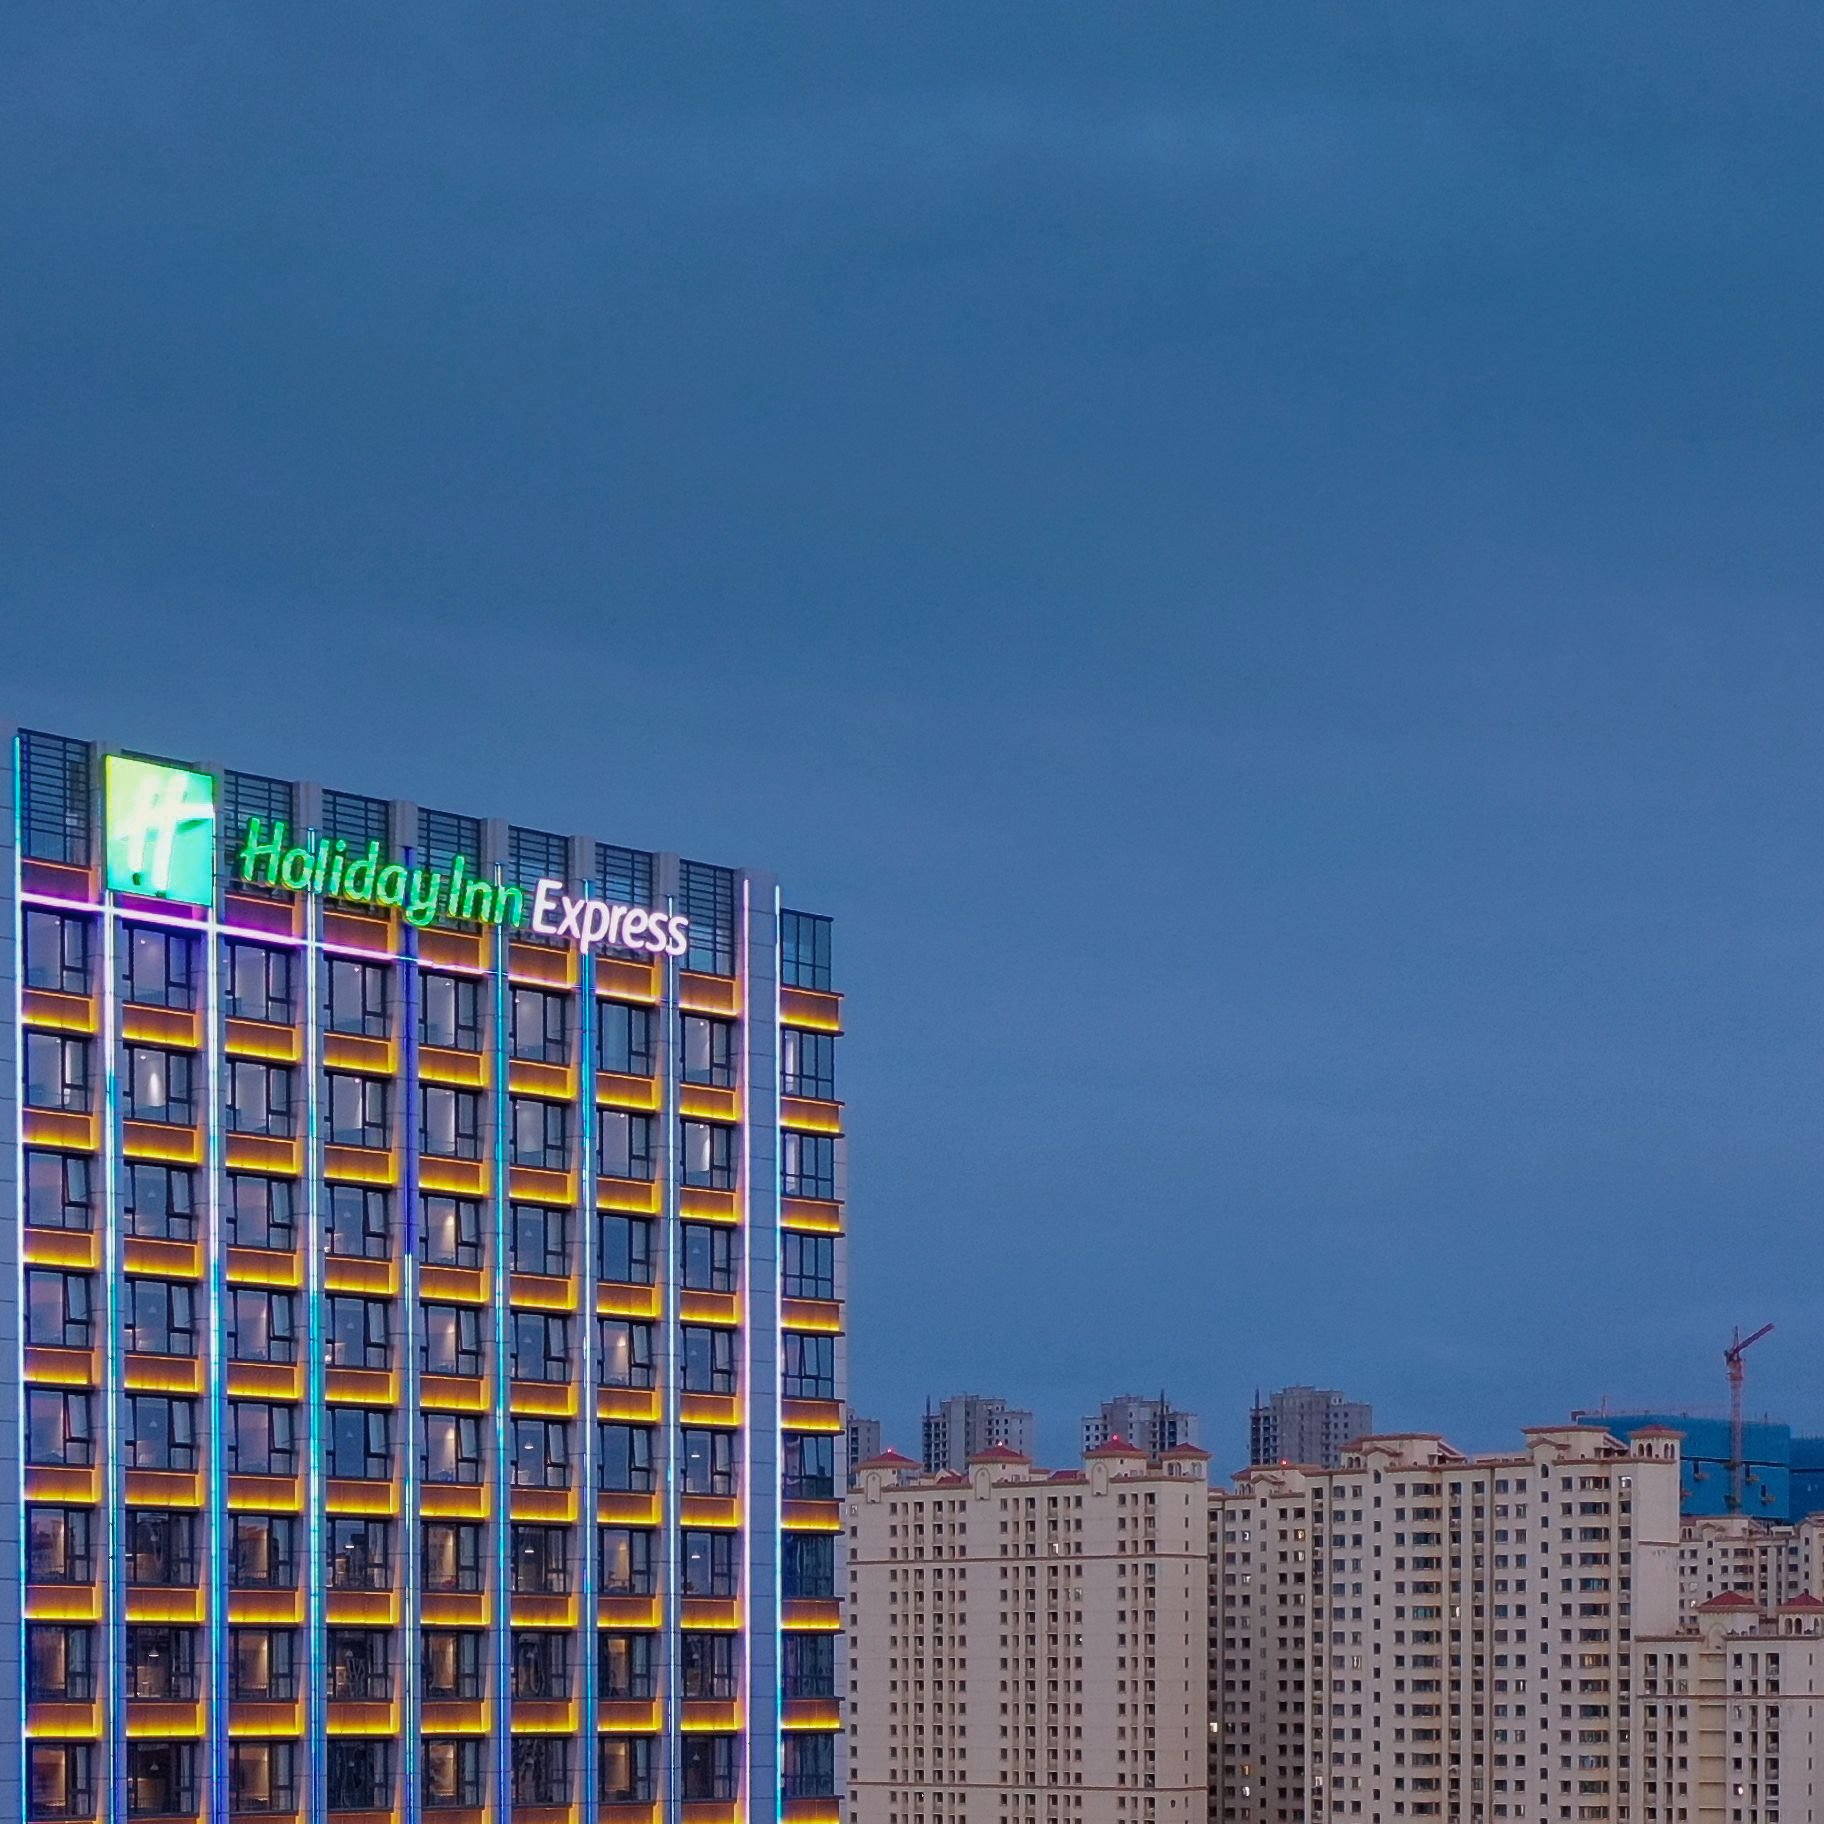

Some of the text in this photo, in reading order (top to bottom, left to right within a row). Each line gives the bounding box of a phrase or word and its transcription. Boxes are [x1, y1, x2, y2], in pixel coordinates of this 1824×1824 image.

[239, 817, 689, 956] Holiday Inn Express
